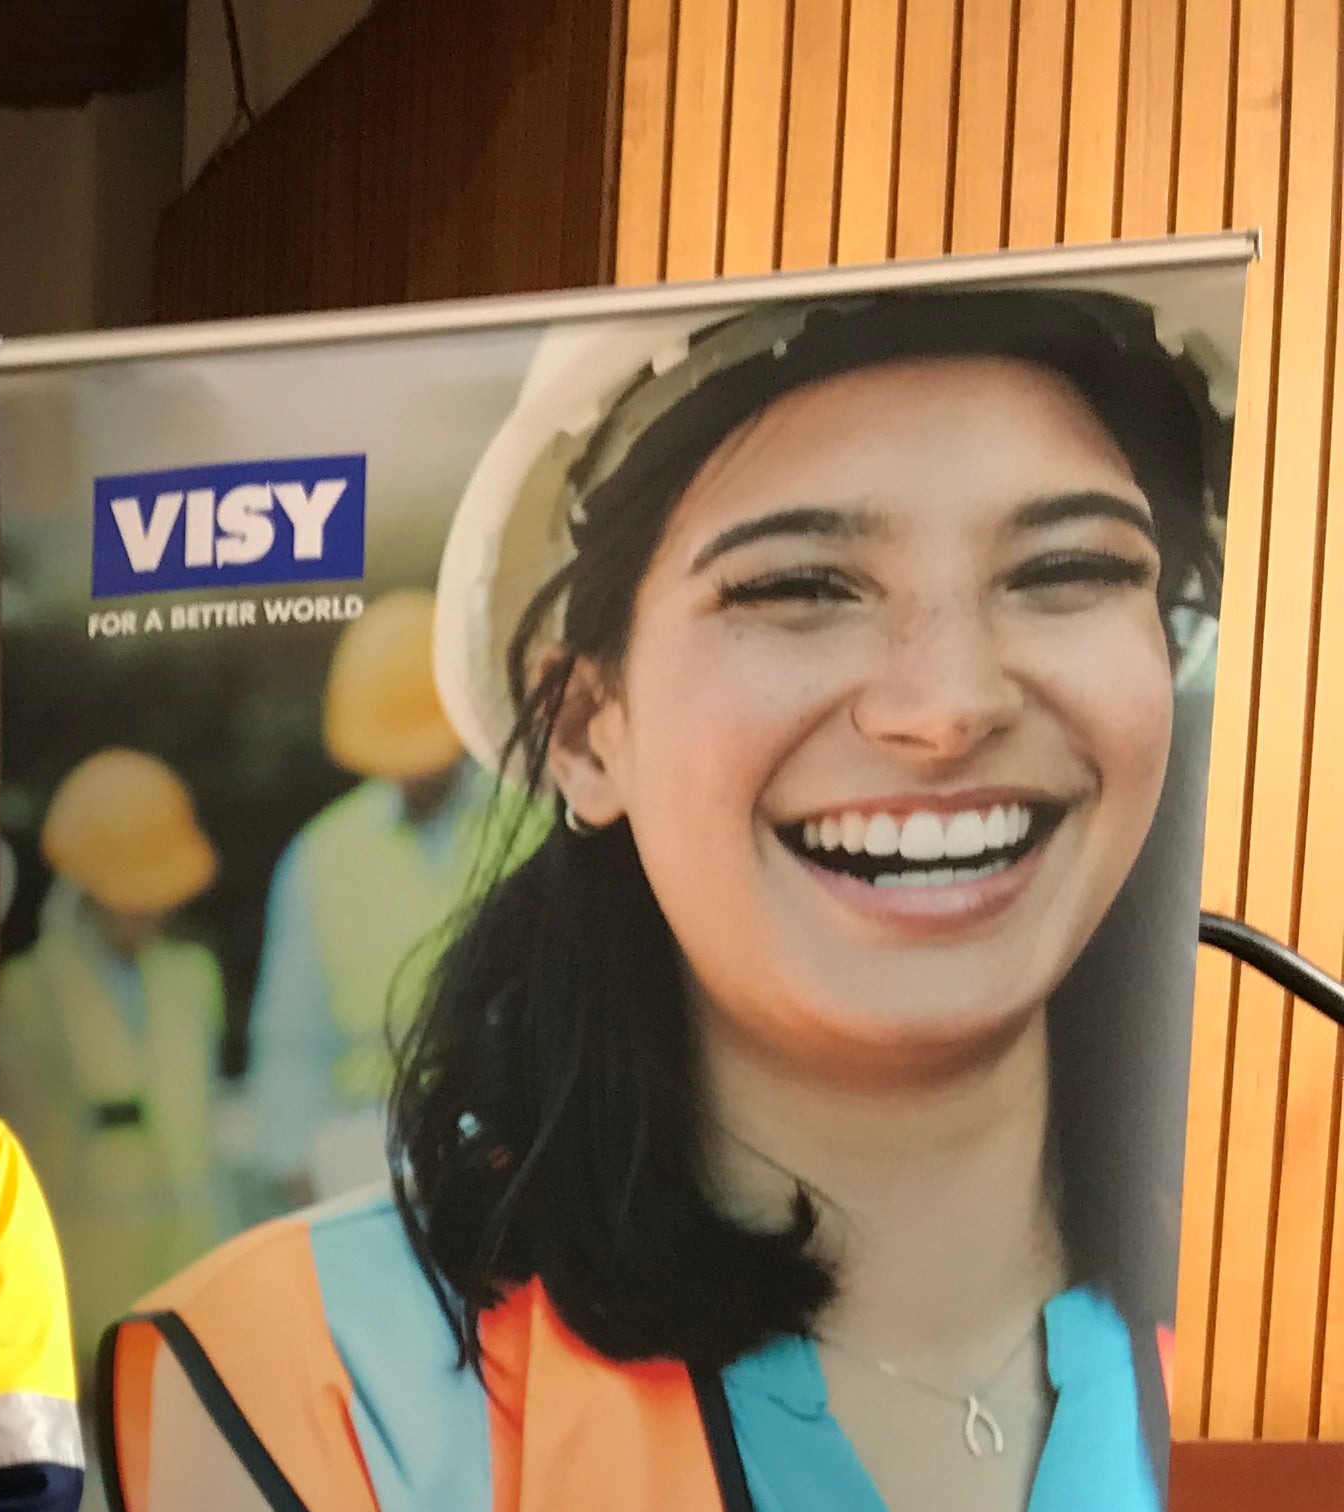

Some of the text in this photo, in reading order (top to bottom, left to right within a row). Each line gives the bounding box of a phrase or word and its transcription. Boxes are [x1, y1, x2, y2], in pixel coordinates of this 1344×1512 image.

[110, 477, 349, 573] VISY
[87, 593, 365, 640] FOR A BETTER WORLD
